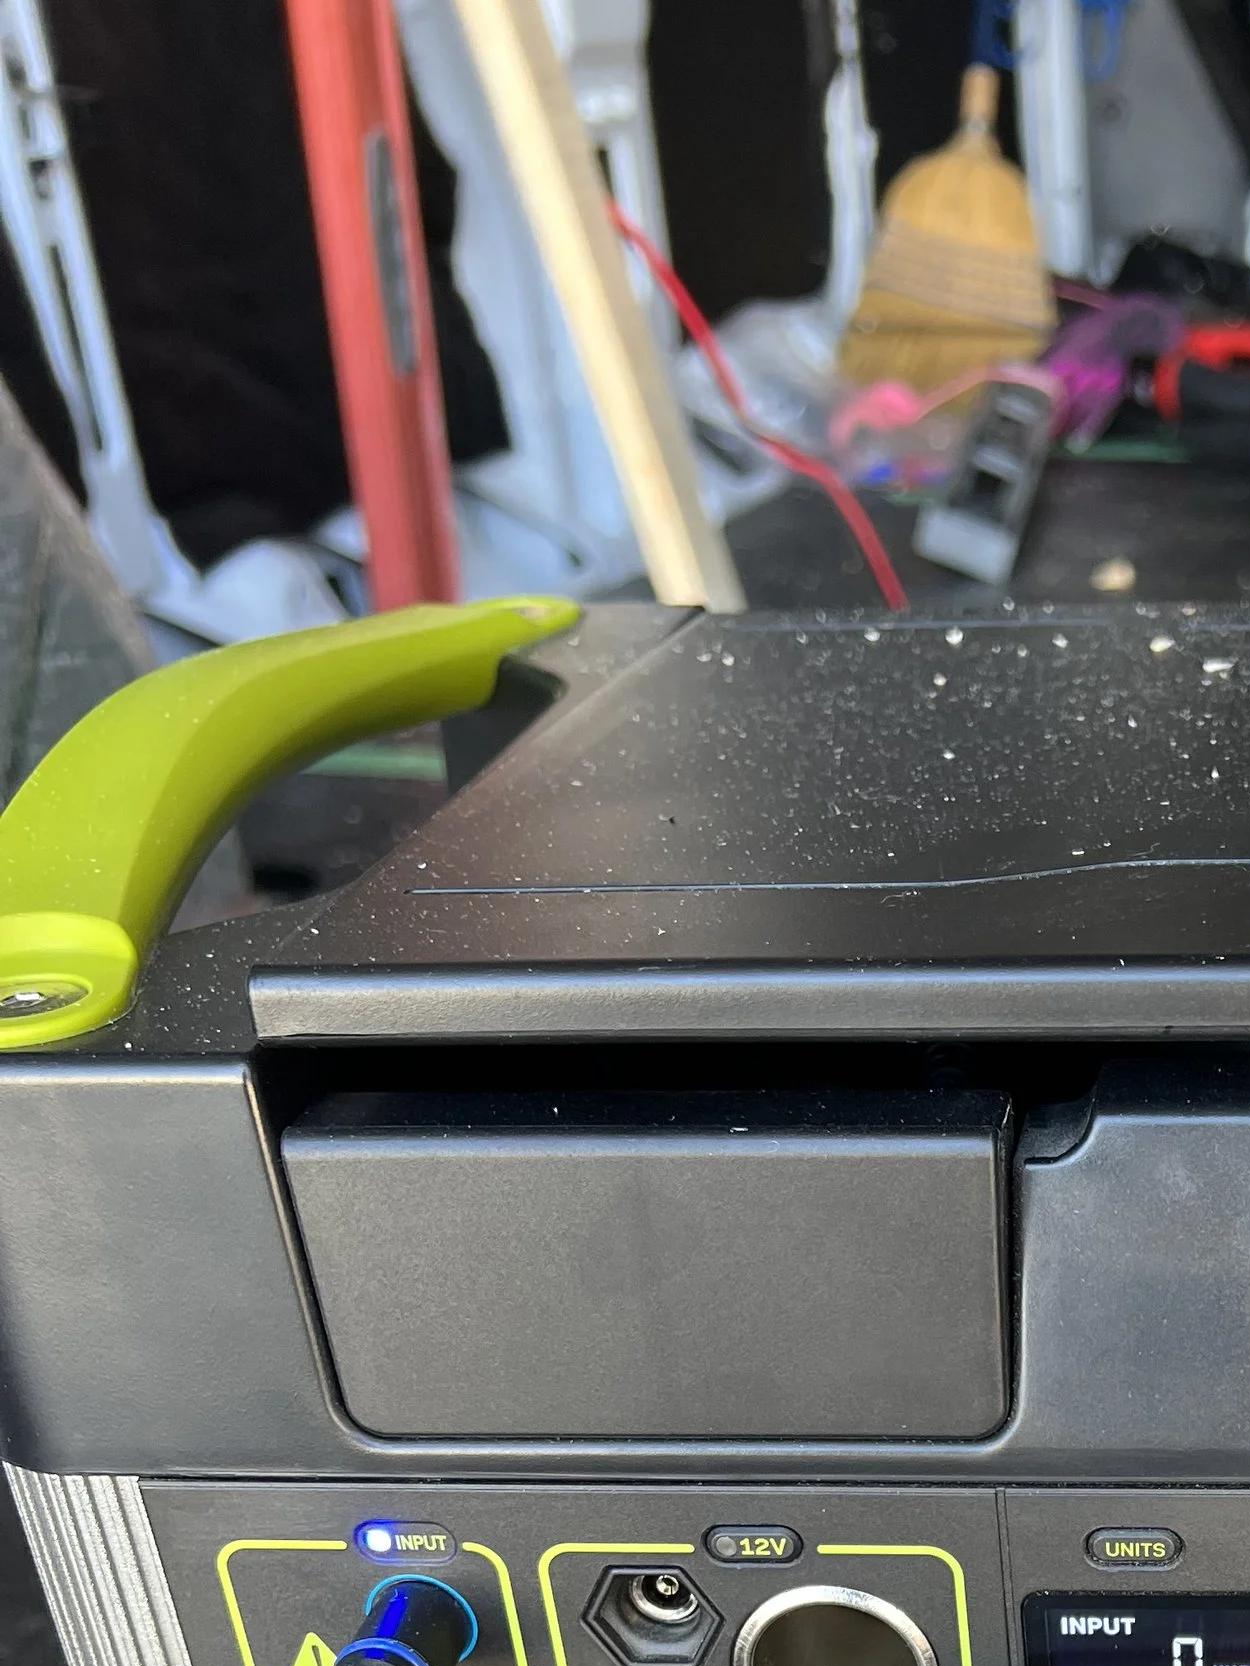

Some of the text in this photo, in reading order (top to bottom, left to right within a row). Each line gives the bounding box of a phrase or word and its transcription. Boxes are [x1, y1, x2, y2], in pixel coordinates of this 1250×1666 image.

[395, 1534, 447, 1551] INPUT
[739, 1538, 787, 1556] 12V
[1105, 1542, 1167, 1558] UNITS
[1060, 1616, 1136, 1636] INPUT
